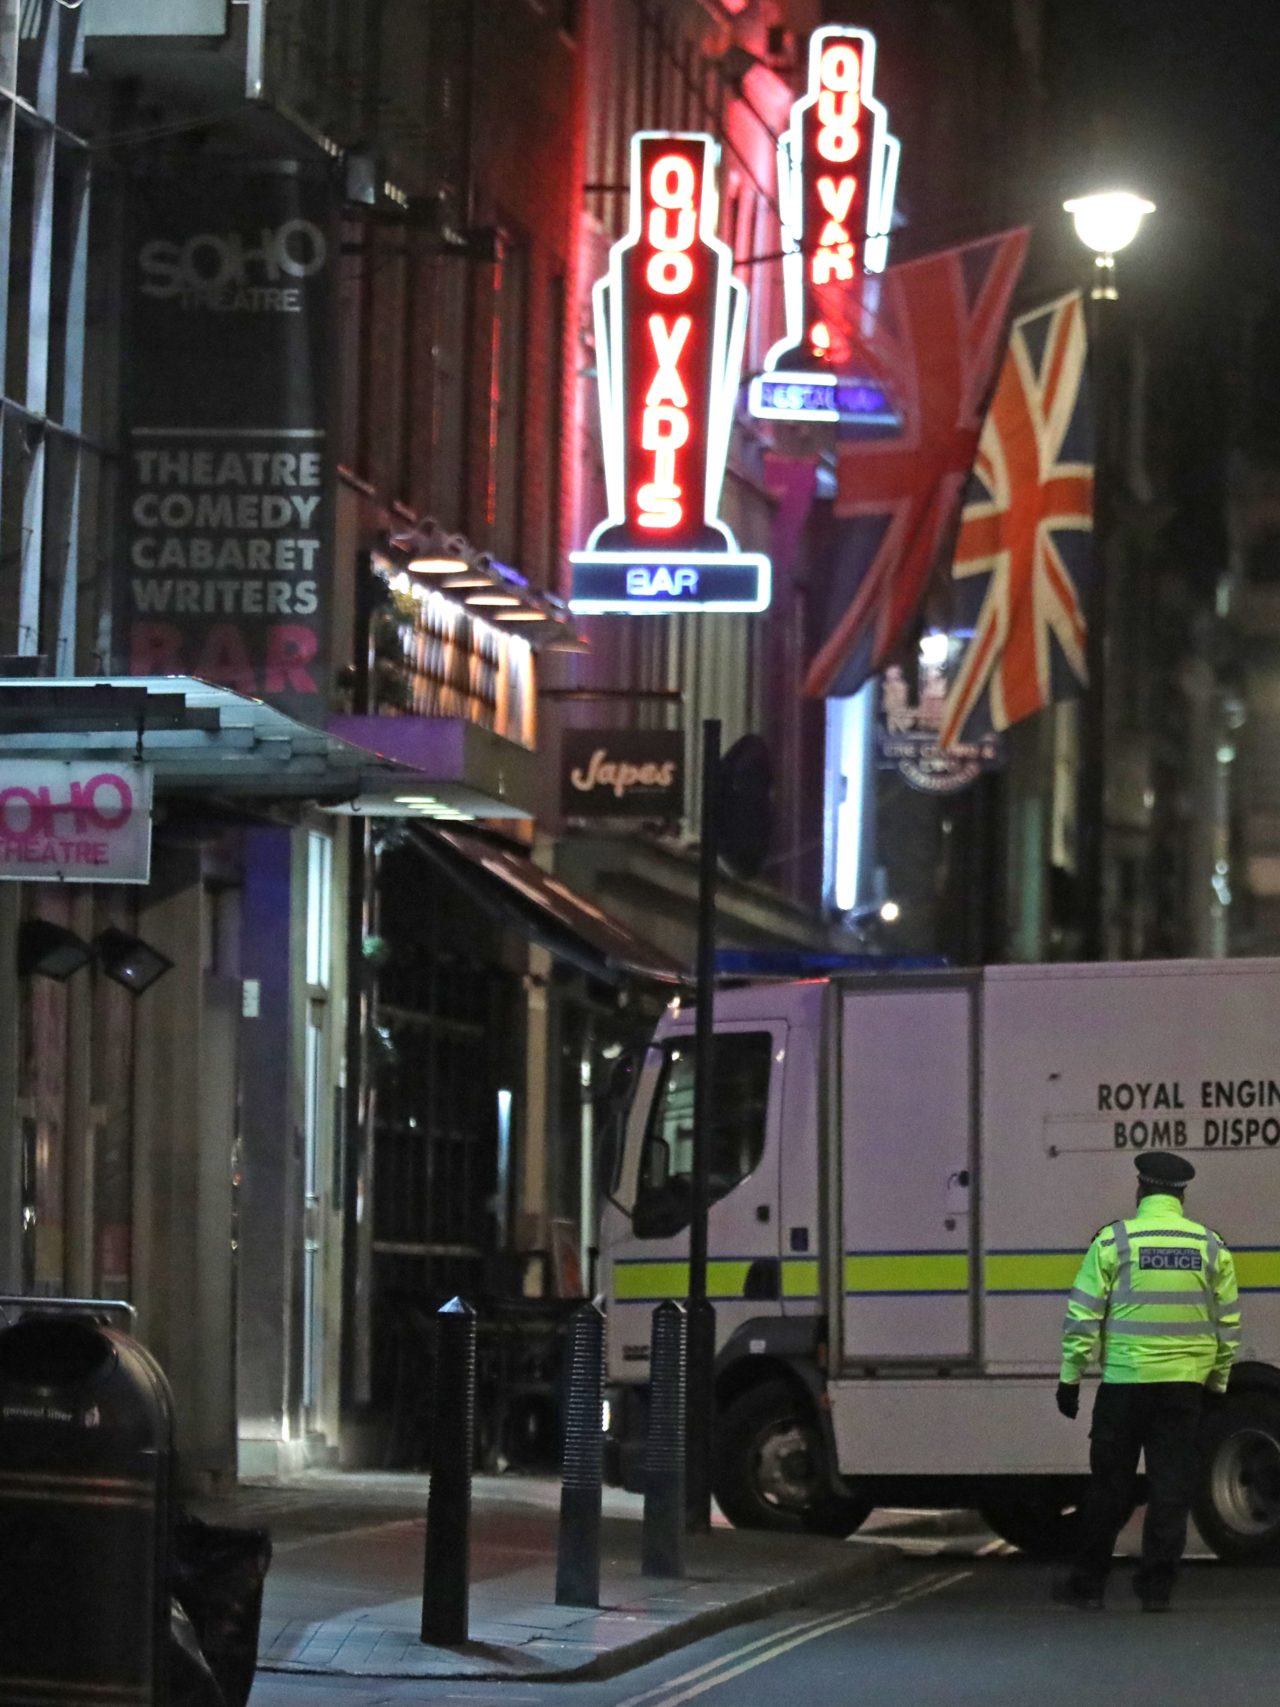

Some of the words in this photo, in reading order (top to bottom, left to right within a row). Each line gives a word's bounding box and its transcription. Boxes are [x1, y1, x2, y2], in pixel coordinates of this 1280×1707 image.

[817, 45, 861, 163] QUO
[646, 156, 696, 294] QUO
[139, 219, 326, 297] SOHO
[180, 287, 302, 313] THEATRE
[636, 313, 692, 529] VADIS
[135, 451, 322, 487] THEATRE
[131, 493, 321, 530] COMEDY
[130, 538, 320, 571] CABARET
[130, 579, 319, 615] WRITERS
[626, 566, 699, 597] BAR
[571, 749, 676, 798] Japes
[0, 772, 133, 841] OHO
[0, 840, 109, 865] HEATRE
[1098, 1083, 1184, 1111] ROYAL
[1114, 1120, 1187, 1148] BOMB
[1141, 1255, 1201, 1269] POLICE
